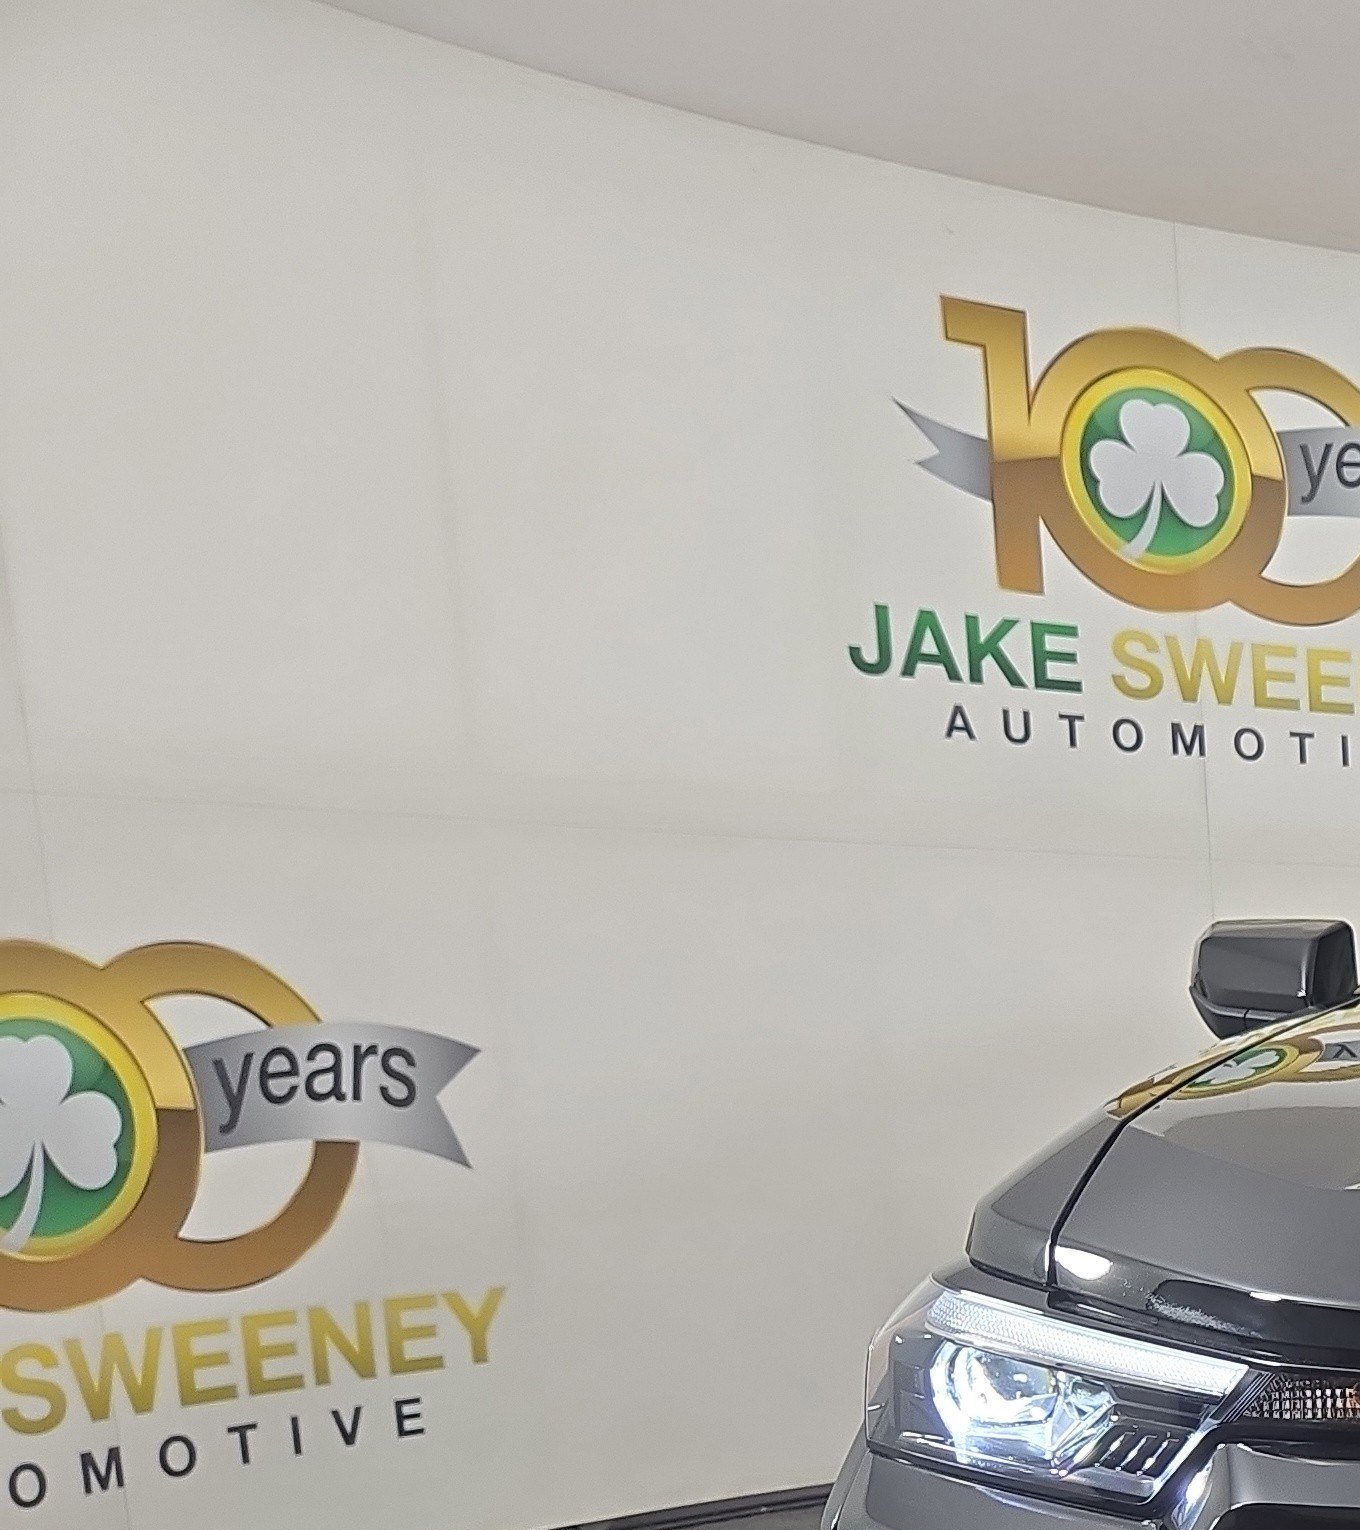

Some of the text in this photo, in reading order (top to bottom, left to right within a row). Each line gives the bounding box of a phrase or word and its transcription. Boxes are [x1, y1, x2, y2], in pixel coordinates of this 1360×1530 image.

[848, 604, 1083, 693] JAKE
[212, 1042, 418, 1134] years
[0, 1286, 506, 1437] SWEENEY
[8, 1397, 426, 1509] OMOTIVE
